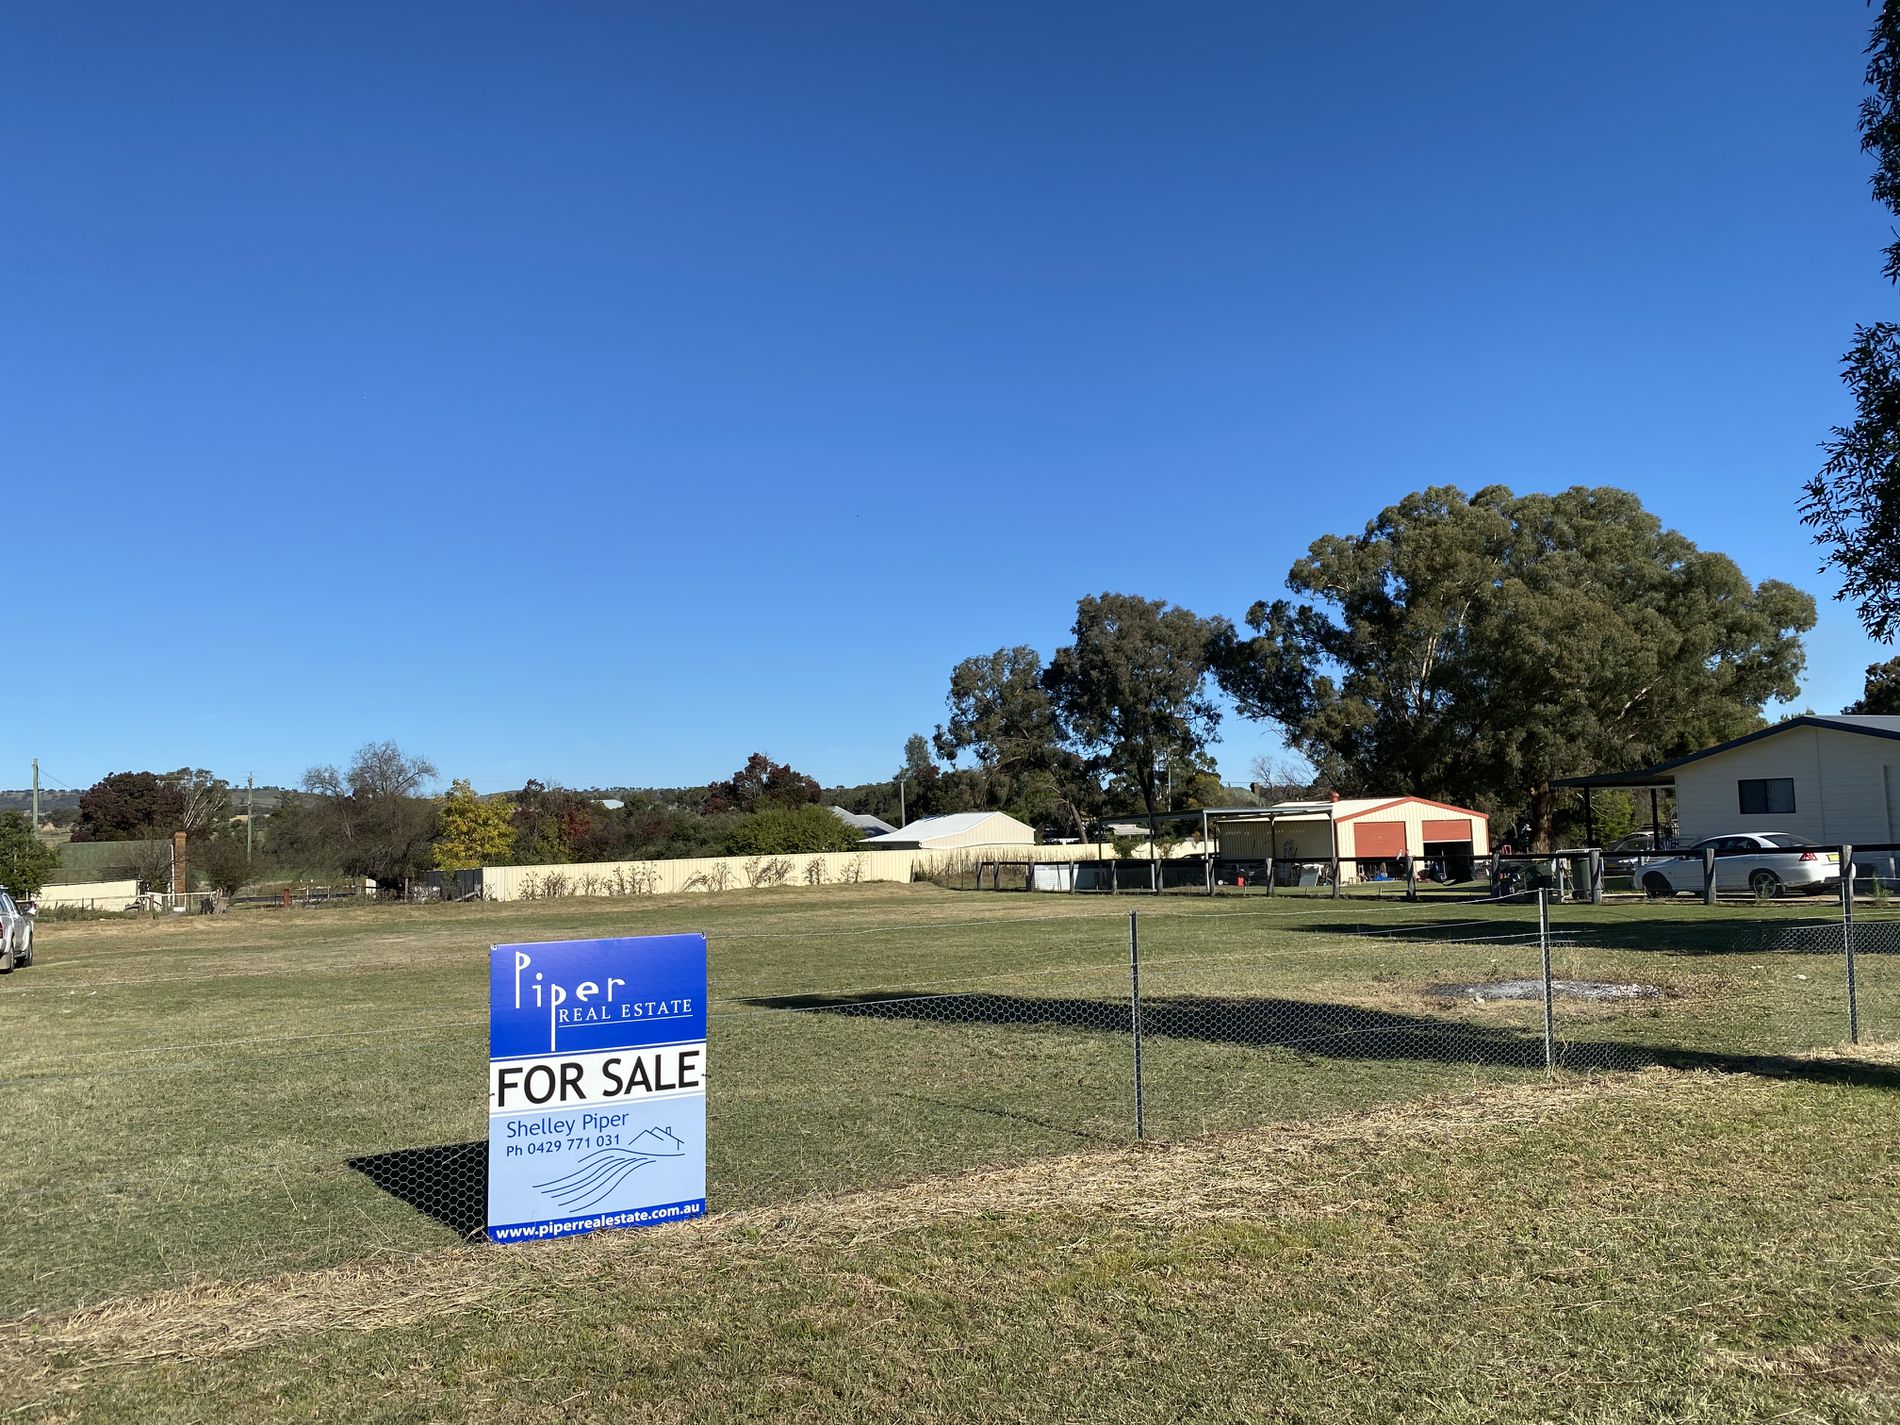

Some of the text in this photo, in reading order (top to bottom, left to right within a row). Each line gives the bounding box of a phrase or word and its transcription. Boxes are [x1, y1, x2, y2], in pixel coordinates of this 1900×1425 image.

[515, 951, 626, 1052] Piper
[558, 999, 693, 1023] REAL ESTATE
[498, 1050, 700, 1107] FOR SALE
[506, 1112, 630, 1139] Shelley Piper
[506, 1134, 620, 1157] Ph 0429 771 031
[496, 1203, 700, 1239] www.piperrealestate.com.au
